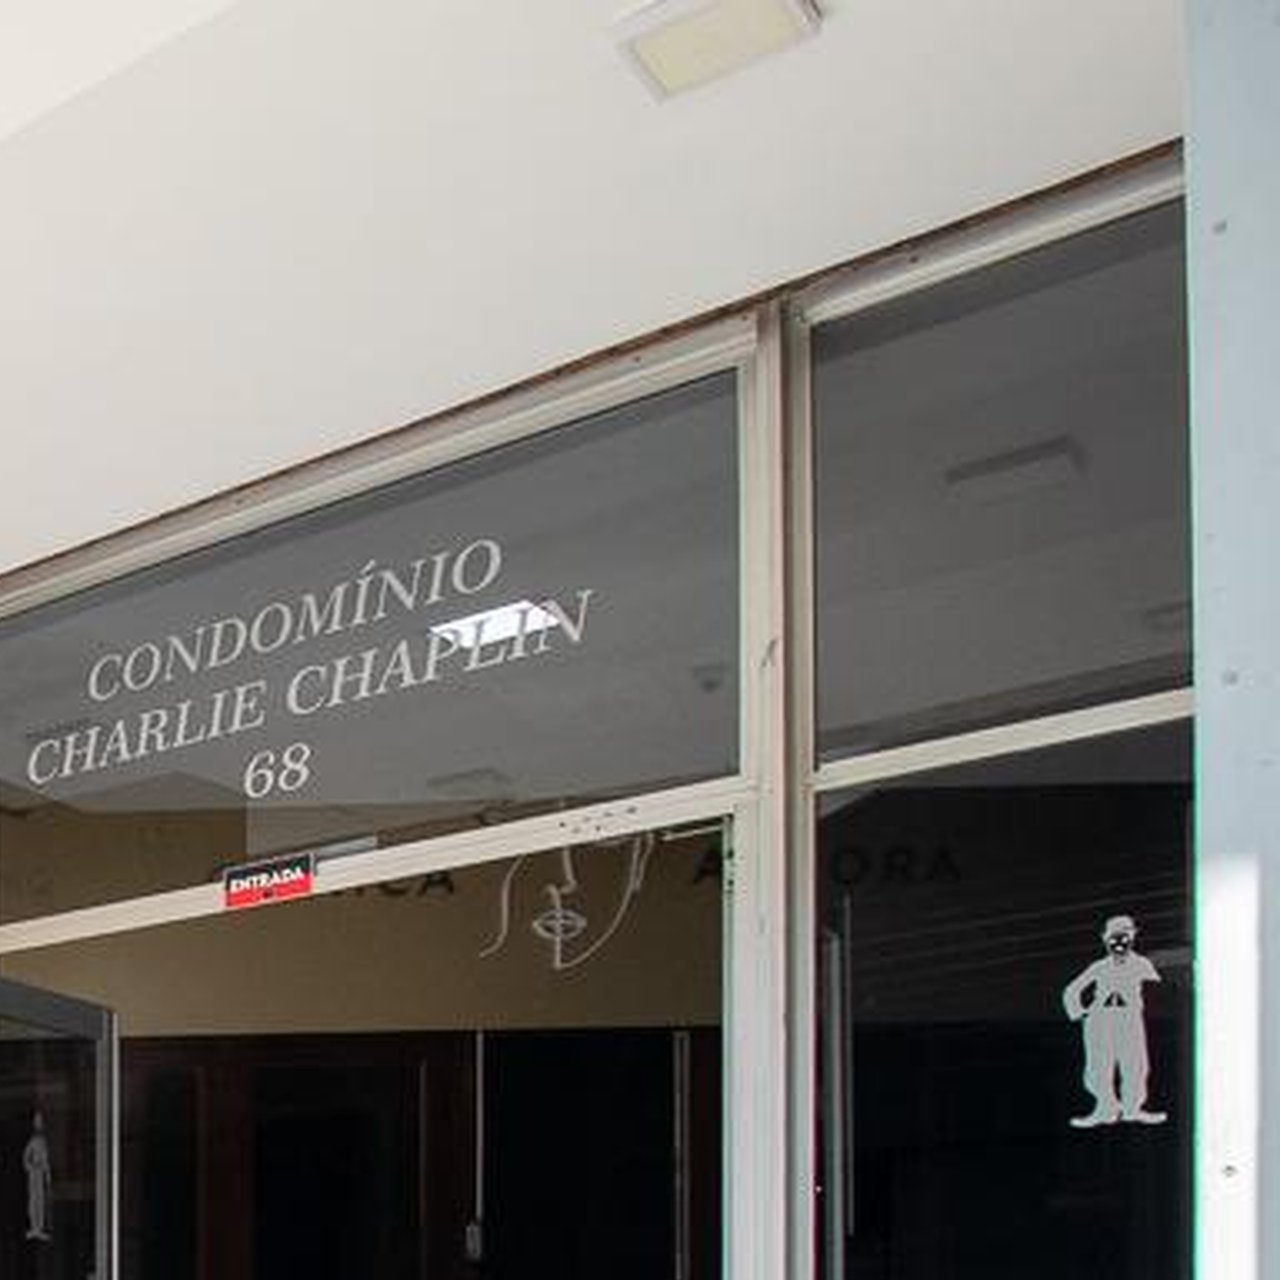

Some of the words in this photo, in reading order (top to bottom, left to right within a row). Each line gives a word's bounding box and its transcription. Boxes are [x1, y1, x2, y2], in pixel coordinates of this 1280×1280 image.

[88, 538, 502, 703] CONDOMÍNIO
[26, 679, 266, 787] CHARLIE
[285, 589, 594, 716] CHAPLIN
[243, 742, 313, 799] 68
[229, 865, 306, 894] ENTRADA
